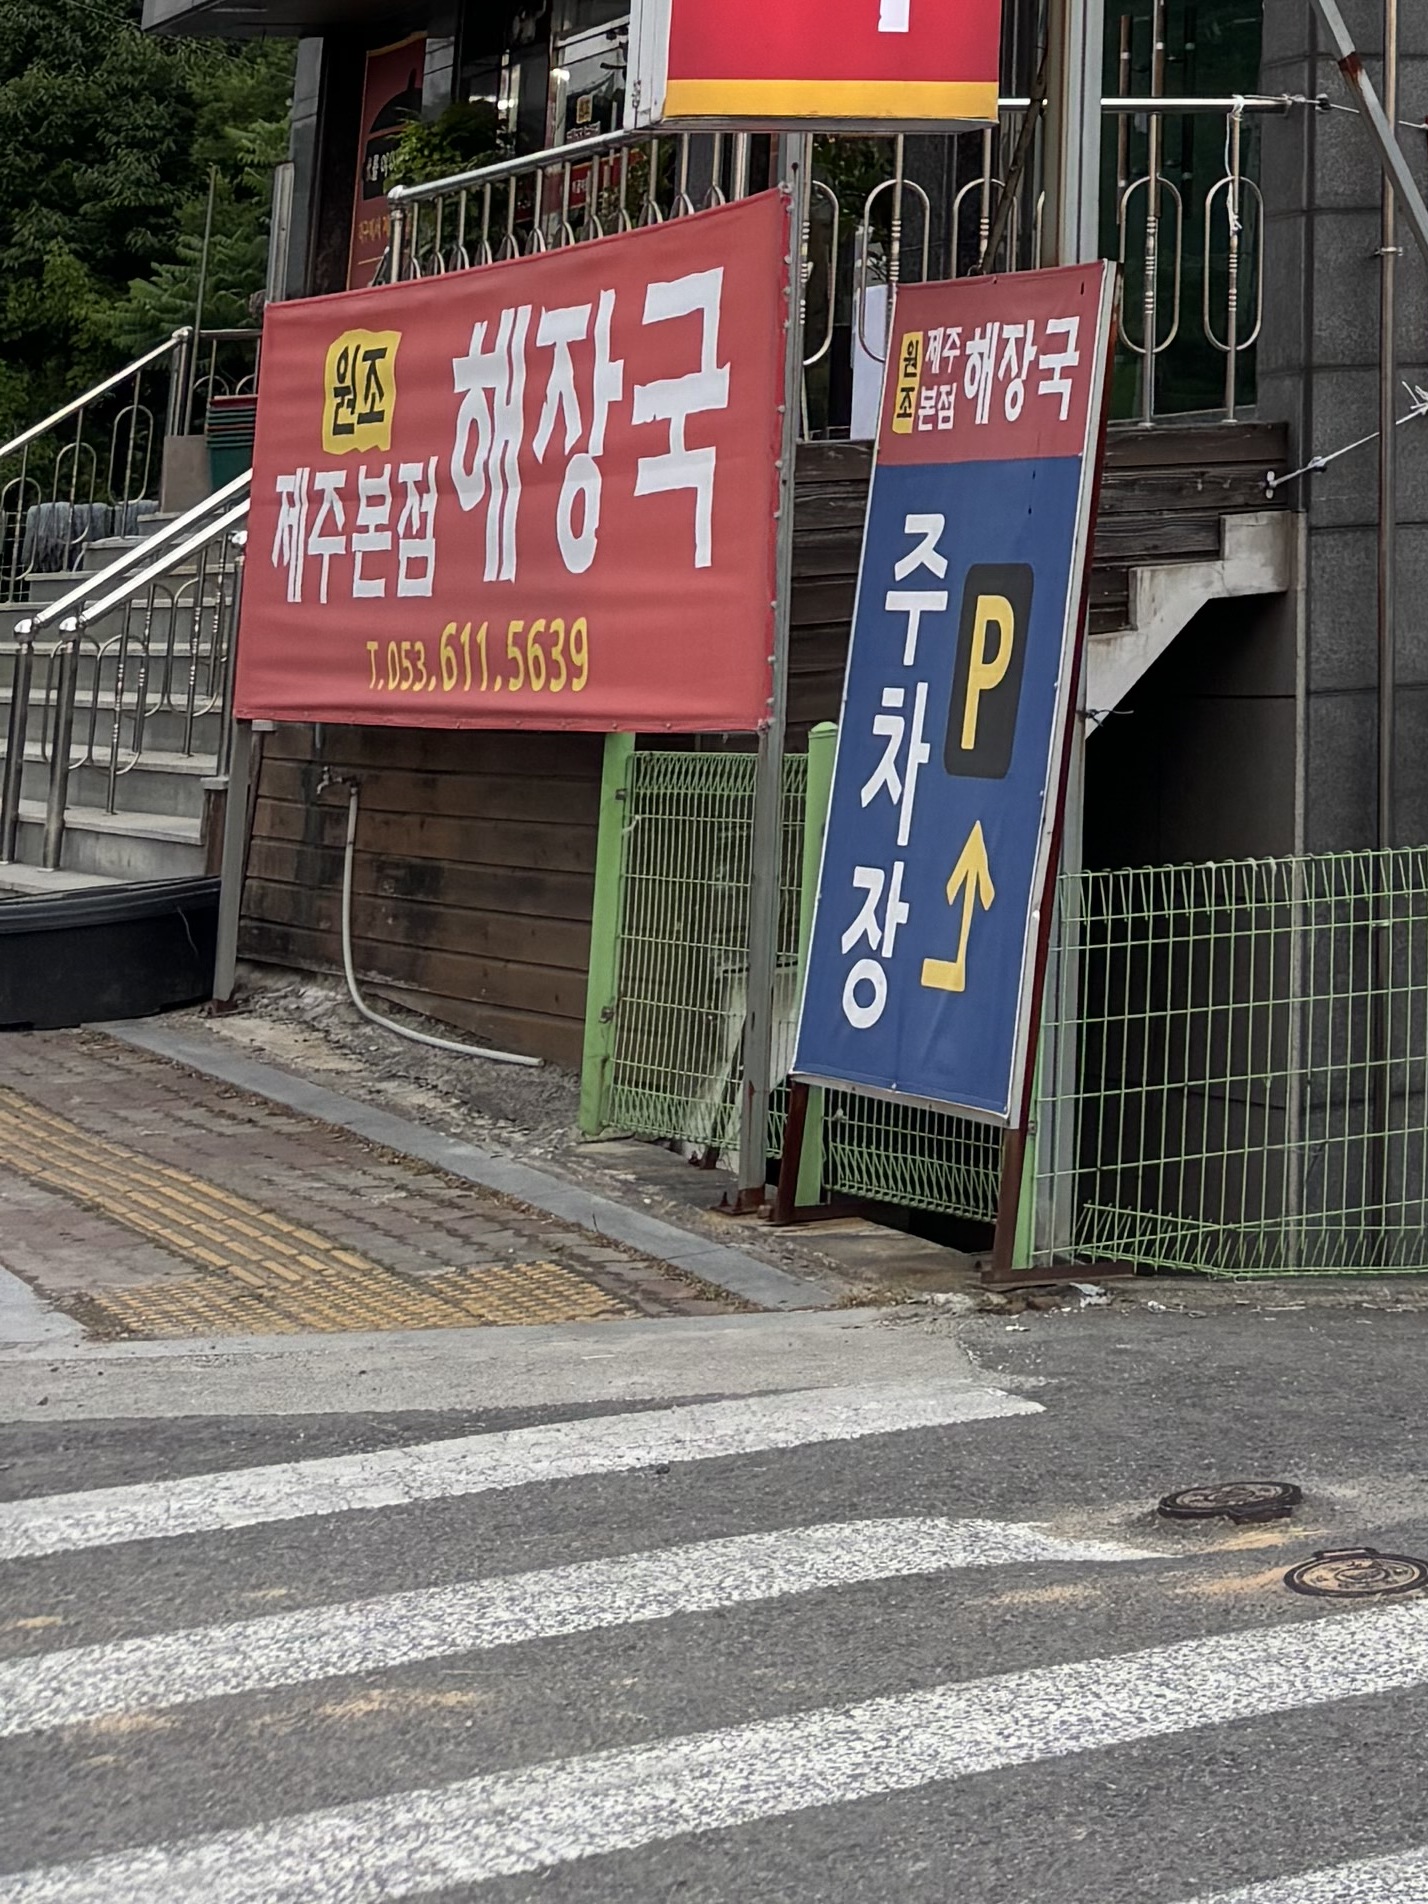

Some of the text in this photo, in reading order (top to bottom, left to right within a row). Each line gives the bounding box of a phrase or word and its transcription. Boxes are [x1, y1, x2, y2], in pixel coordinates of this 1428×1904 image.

[332, 343, 389, 437] 원조
[896, 339, 919, 419] 원조
[925, 326, 963, 374] 제주
[963, 315, 1081, 425] 해장국
[450, 265, 732, 584] 해장국
[918, 381, 957, 432] 본점
[270, 455, 439, 604] 제주본점
[366, 616, 590, 693] T.053.611.5639
[960, 593, 1016, 751] P
[841, 512, 949, 1030] 주차장
